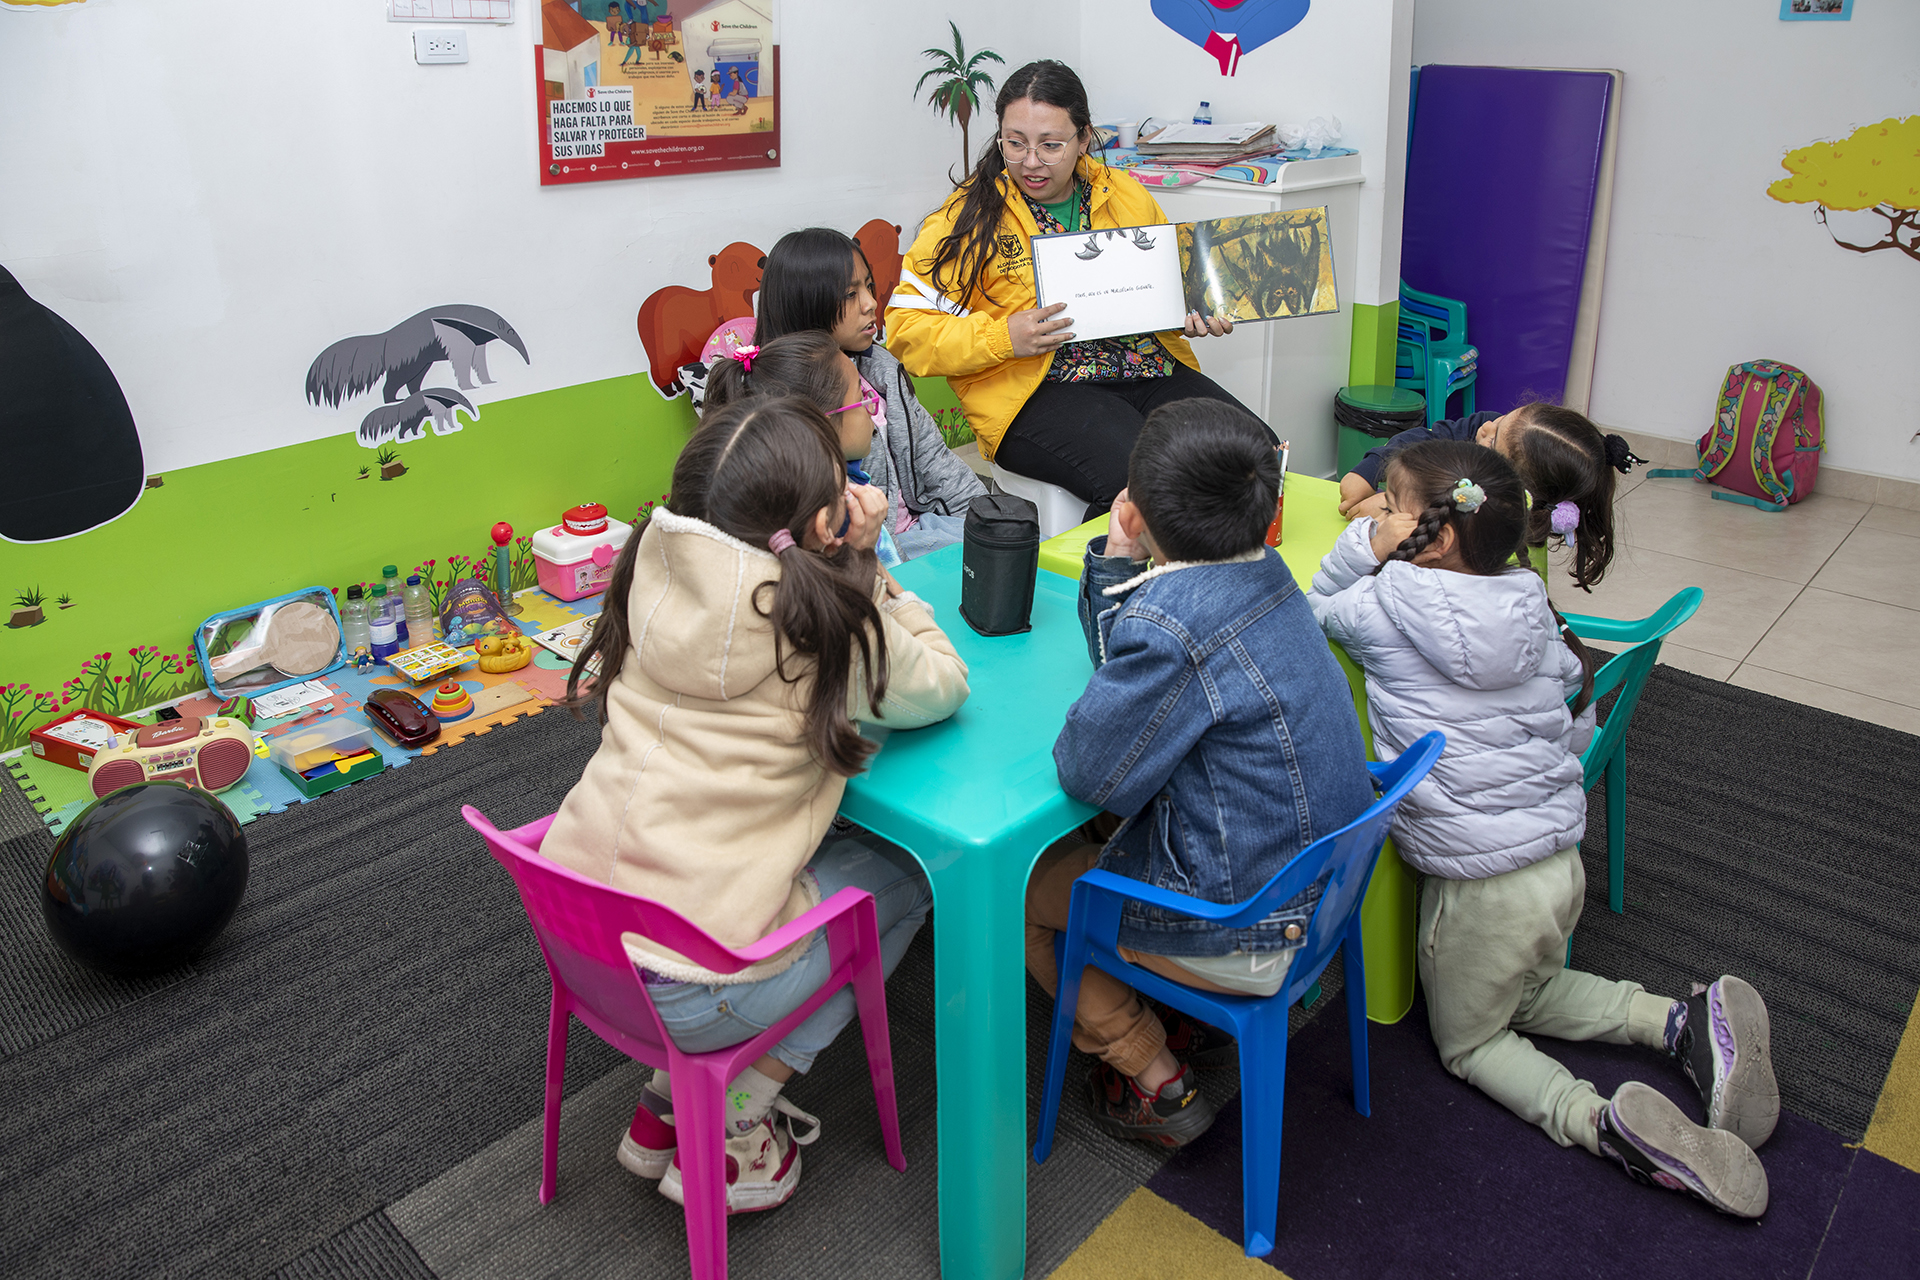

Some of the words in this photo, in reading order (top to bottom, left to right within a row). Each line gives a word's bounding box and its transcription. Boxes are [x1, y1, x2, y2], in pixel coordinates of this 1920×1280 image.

[553, 102, 597, 114] HACEMOS
[600, 101, 610, 112] LO
[614, 101, 631, 112] QUE
[554, 117, 578, 128] HAGA
[581, 116, 606, 127] FALTA
[609, 115, 632, 126] PARA
[554, 130, 587, 142] SALVAR
[590, 130, 595, 140] Y
[599, 128, 644, 140] PROTEGER
[555, 145, 572, 156] SUS
[575, 144, 602, 155] VIDAS
[631, 146, 704, 155] www.savethechildren.org.co
[458, 597, 488, 608] Mundos
[152, 726, 184, 739] Barbie
